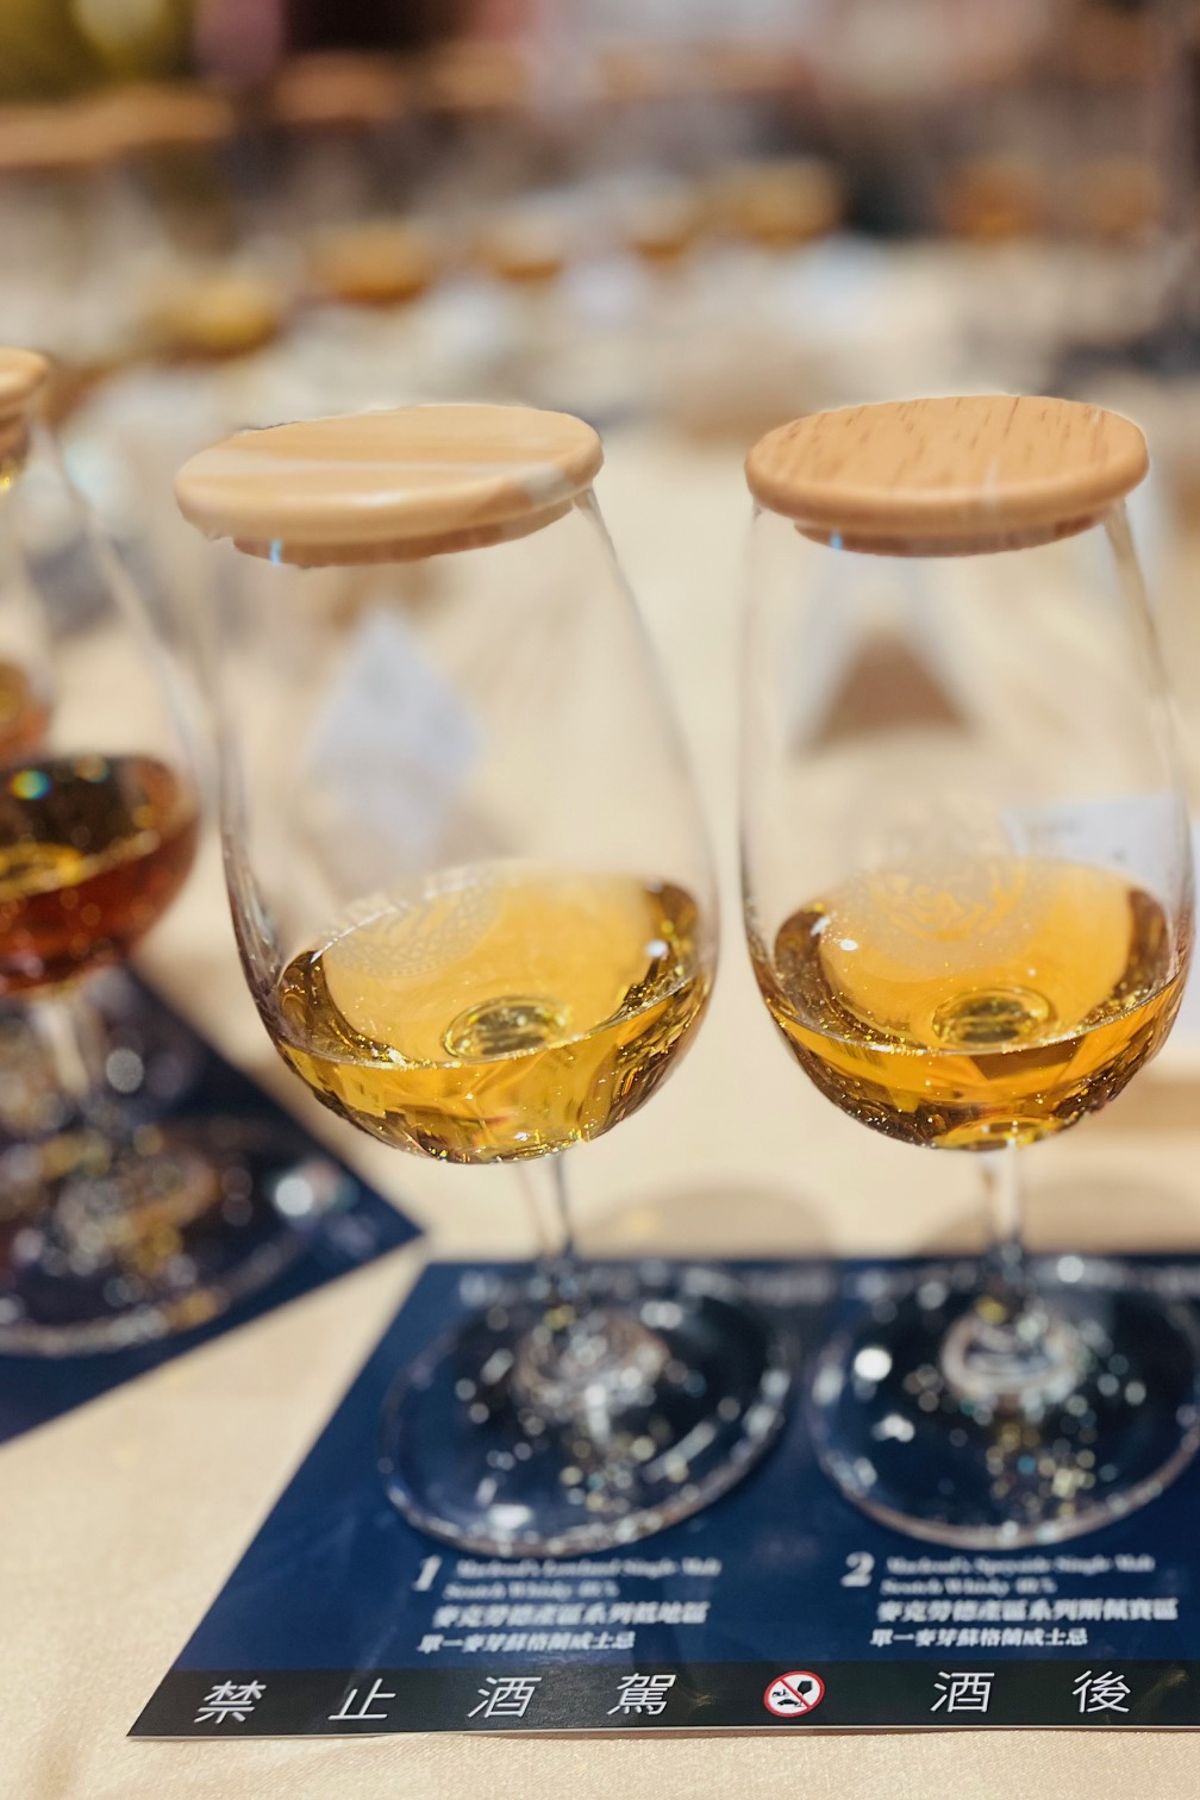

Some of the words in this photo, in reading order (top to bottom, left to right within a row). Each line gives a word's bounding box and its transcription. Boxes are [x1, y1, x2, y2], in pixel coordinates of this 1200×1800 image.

[414, 1555, 442, 1592] 1
[841, 1552, 874, 1588] 2
[194, 1672, 677, 1724] 禁止酒駕
